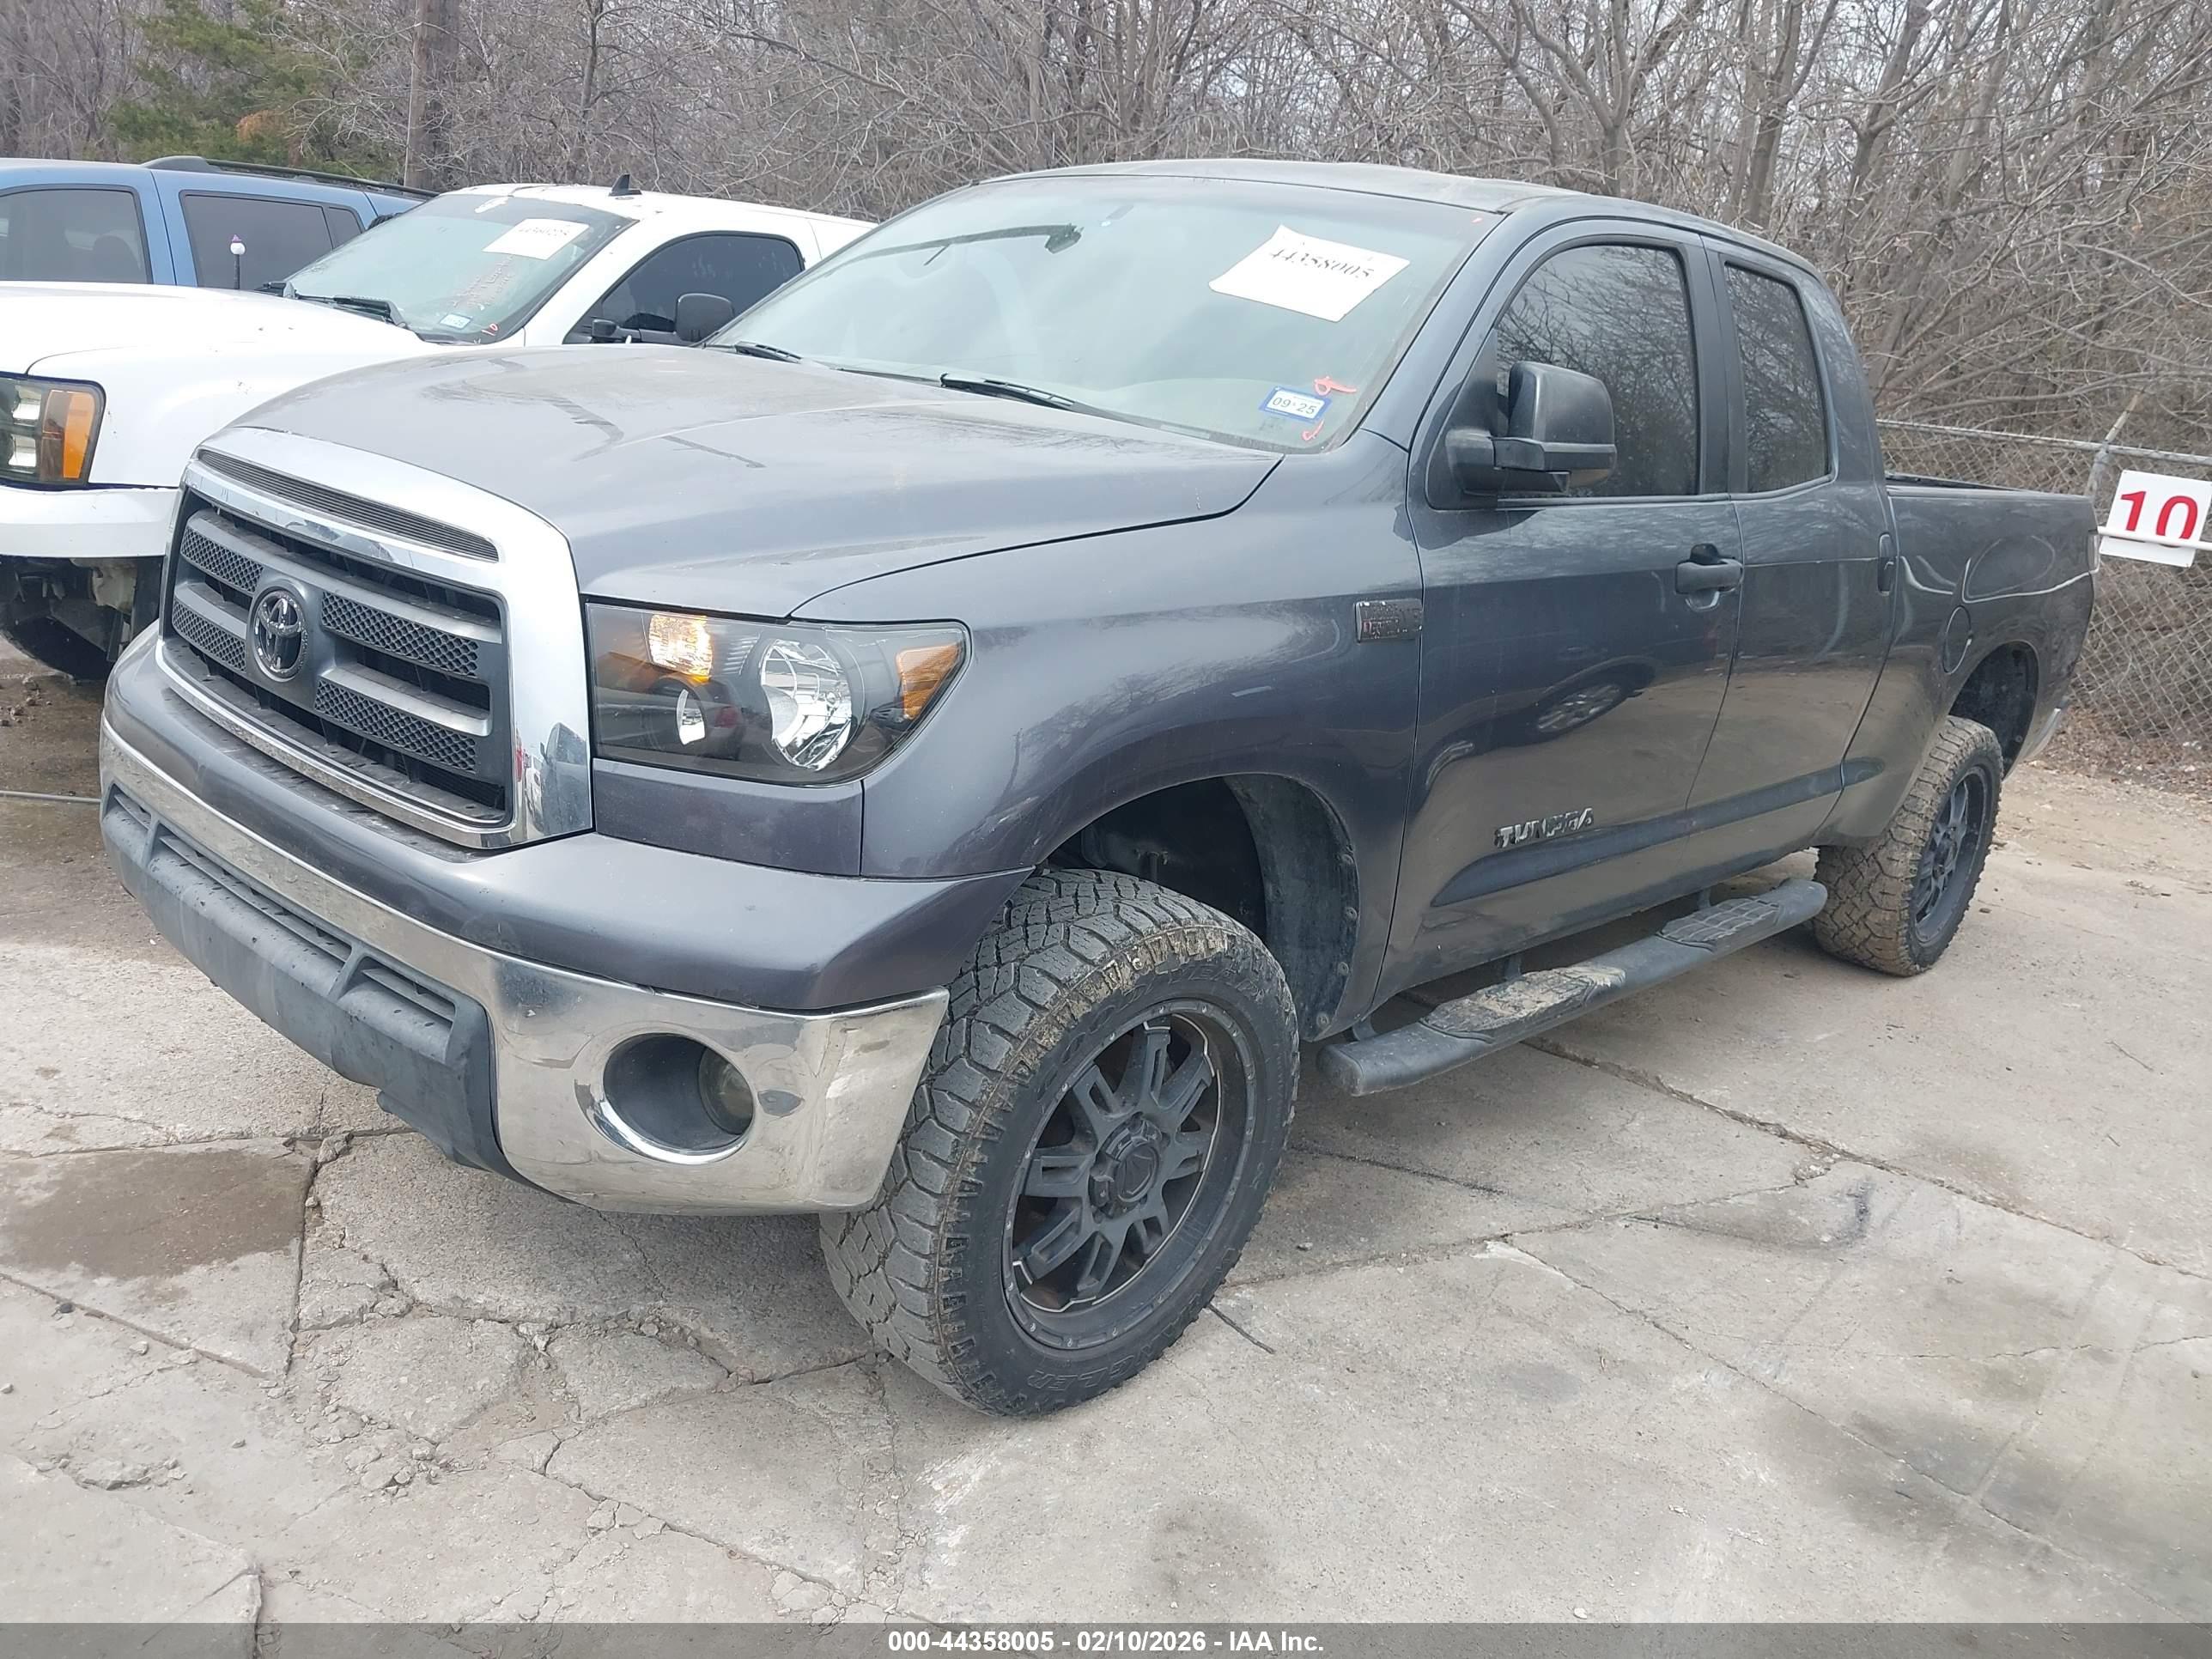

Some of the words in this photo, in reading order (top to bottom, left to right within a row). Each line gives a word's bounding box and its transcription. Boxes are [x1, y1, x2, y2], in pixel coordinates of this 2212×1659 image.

[1272, 397, 1291, 408] 09
[1296, 403, 1317, 415] 25
[2120, 490, 2198, 539] 10
